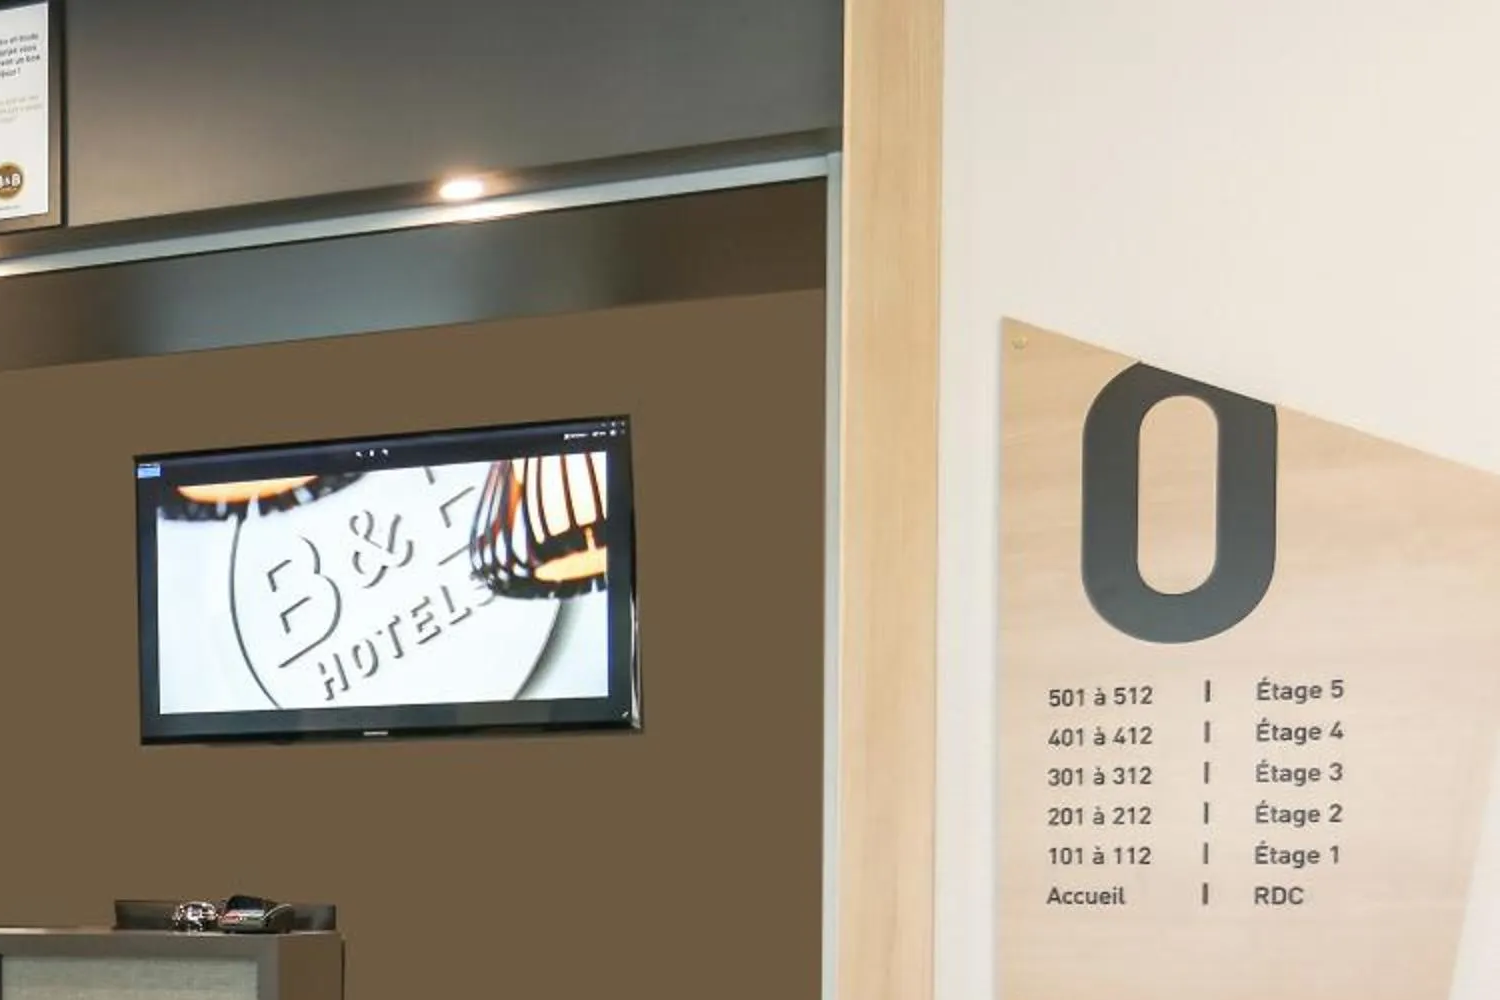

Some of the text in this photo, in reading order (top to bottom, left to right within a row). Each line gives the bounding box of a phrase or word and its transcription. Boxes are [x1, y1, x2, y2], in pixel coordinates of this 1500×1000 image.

[1048, 685, 1154, 708] 501 à 512
[1256, 677, 1345, 705] Étage 5
[1047, 726, 1153, 748] 401 à 412
[1256, 717, 1345, 747] Étage 4
[1047, 766, 1153, 787] 301 à 312
[1255, 758, 1344, 787] Étage 3
[1047, 806, 1152, 827] 201 à 212
[1255, 800, 1344, 829] Étage 2
[1048, 846, 1152, 866] 101 à 112
[1254, 840, 1340, 870] Étage 1
[1046, 886, 1127, 906] Accueil
[1254, 886, 1305, 906] RDC
